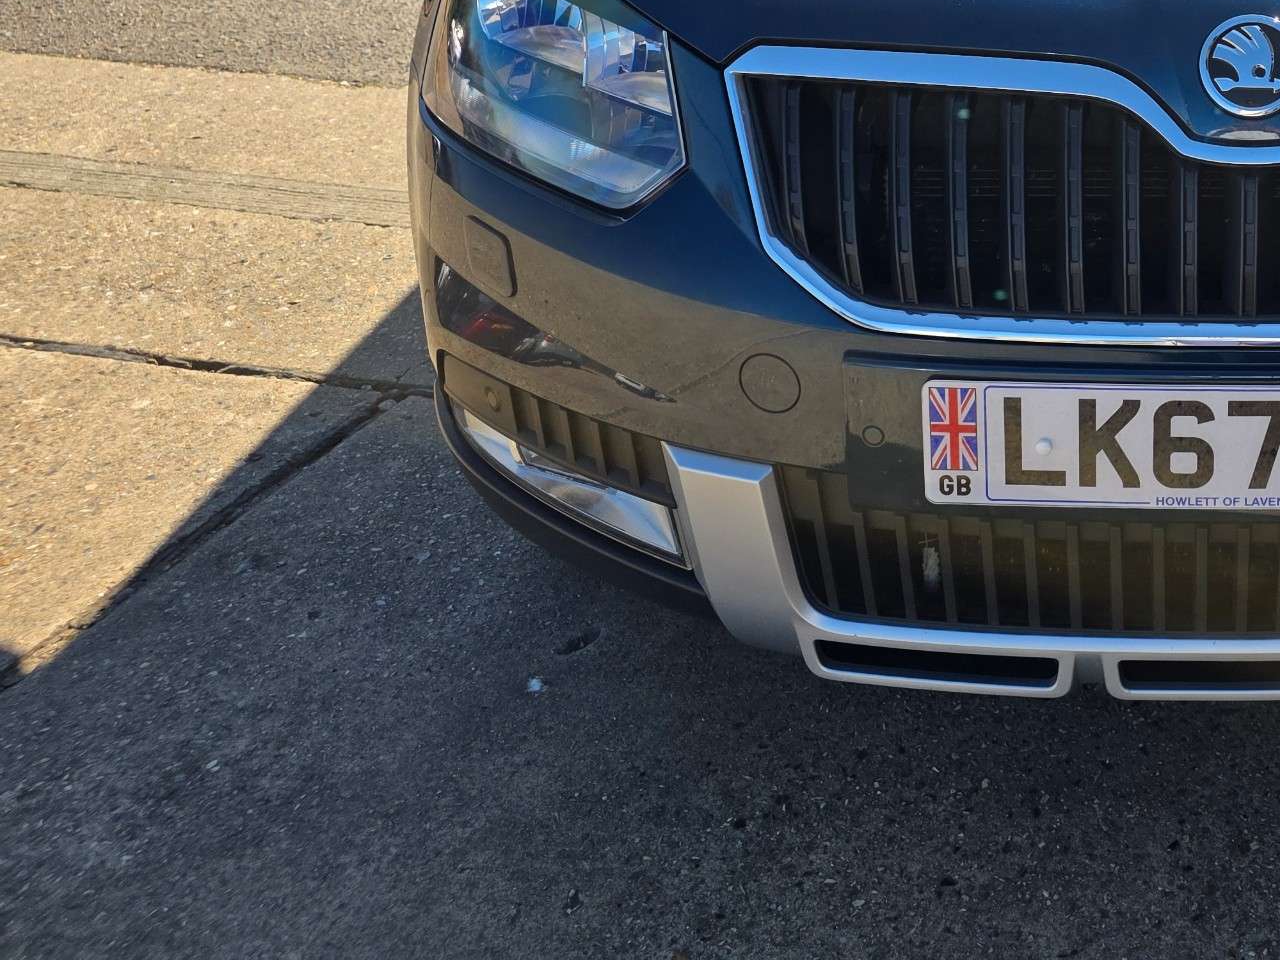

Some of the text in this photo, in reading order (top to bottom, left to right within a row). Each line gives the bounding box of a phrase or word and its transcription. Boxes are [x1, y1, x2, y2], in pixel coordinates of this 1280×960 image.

[939, 474, 972, 496] GB
[1155, 496, 1219, 507] HOWLETT
[1222, 496, 1241, 507] OF
